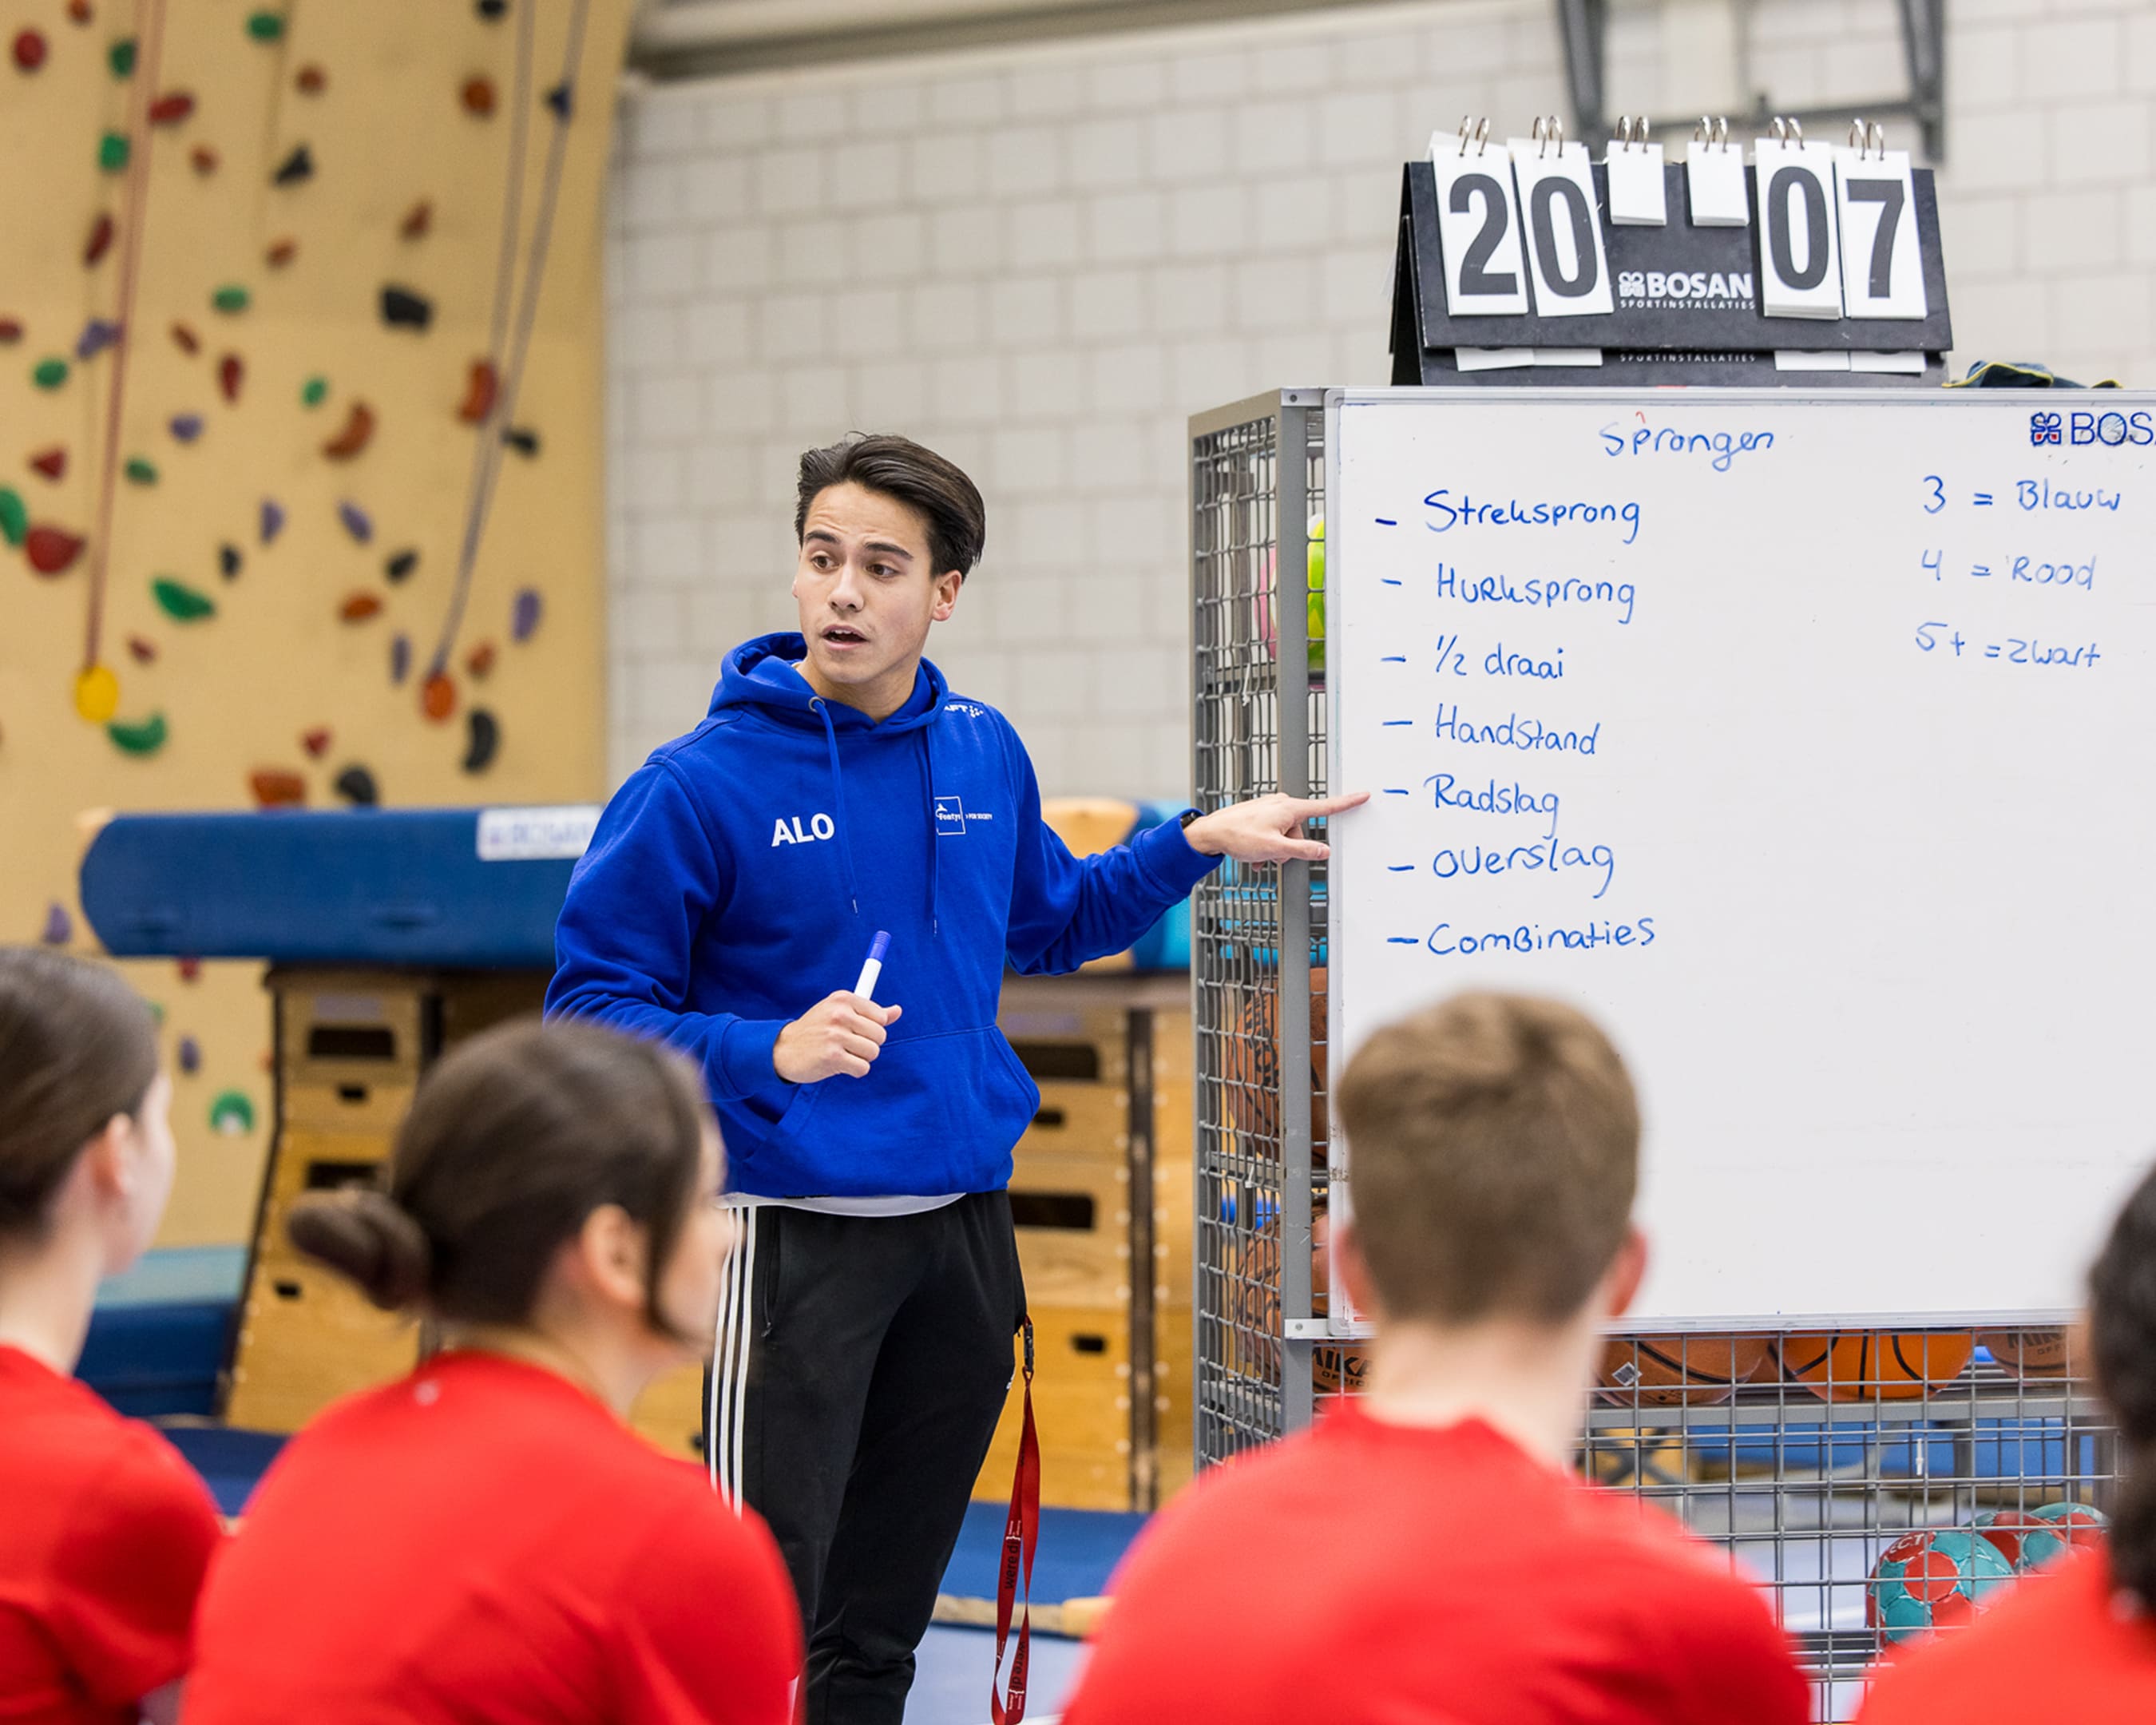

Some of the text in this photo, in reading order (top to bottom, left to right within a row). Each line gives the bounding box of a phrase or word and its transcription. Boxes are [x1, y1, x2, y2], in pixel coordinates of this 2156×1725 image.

[1449, 172, 1598, 299] 20
[1767, 166, 1905, 299] 07
[1620, 299, 1756, 310] SPORTINSTALLATIES
[1646, 272, 1754, 299] BOSAN
[1599, 422, 1775, 473] Sprongen
[2070, 411, 2156, 446] BOS
[1923, 474, 1947, 514] 3
[2015, 478, 2121, 511] Blauw
[1423, 489, 1641, 545] Streksprong
[1921, 549, 1943, 582] 4
[2011, 555, 2097, 591] Rood
[1484, 641, 1565, 680] draai
[1423, 773, 1560, 840] Radslag
[771, 813, 835, 847] ALO
